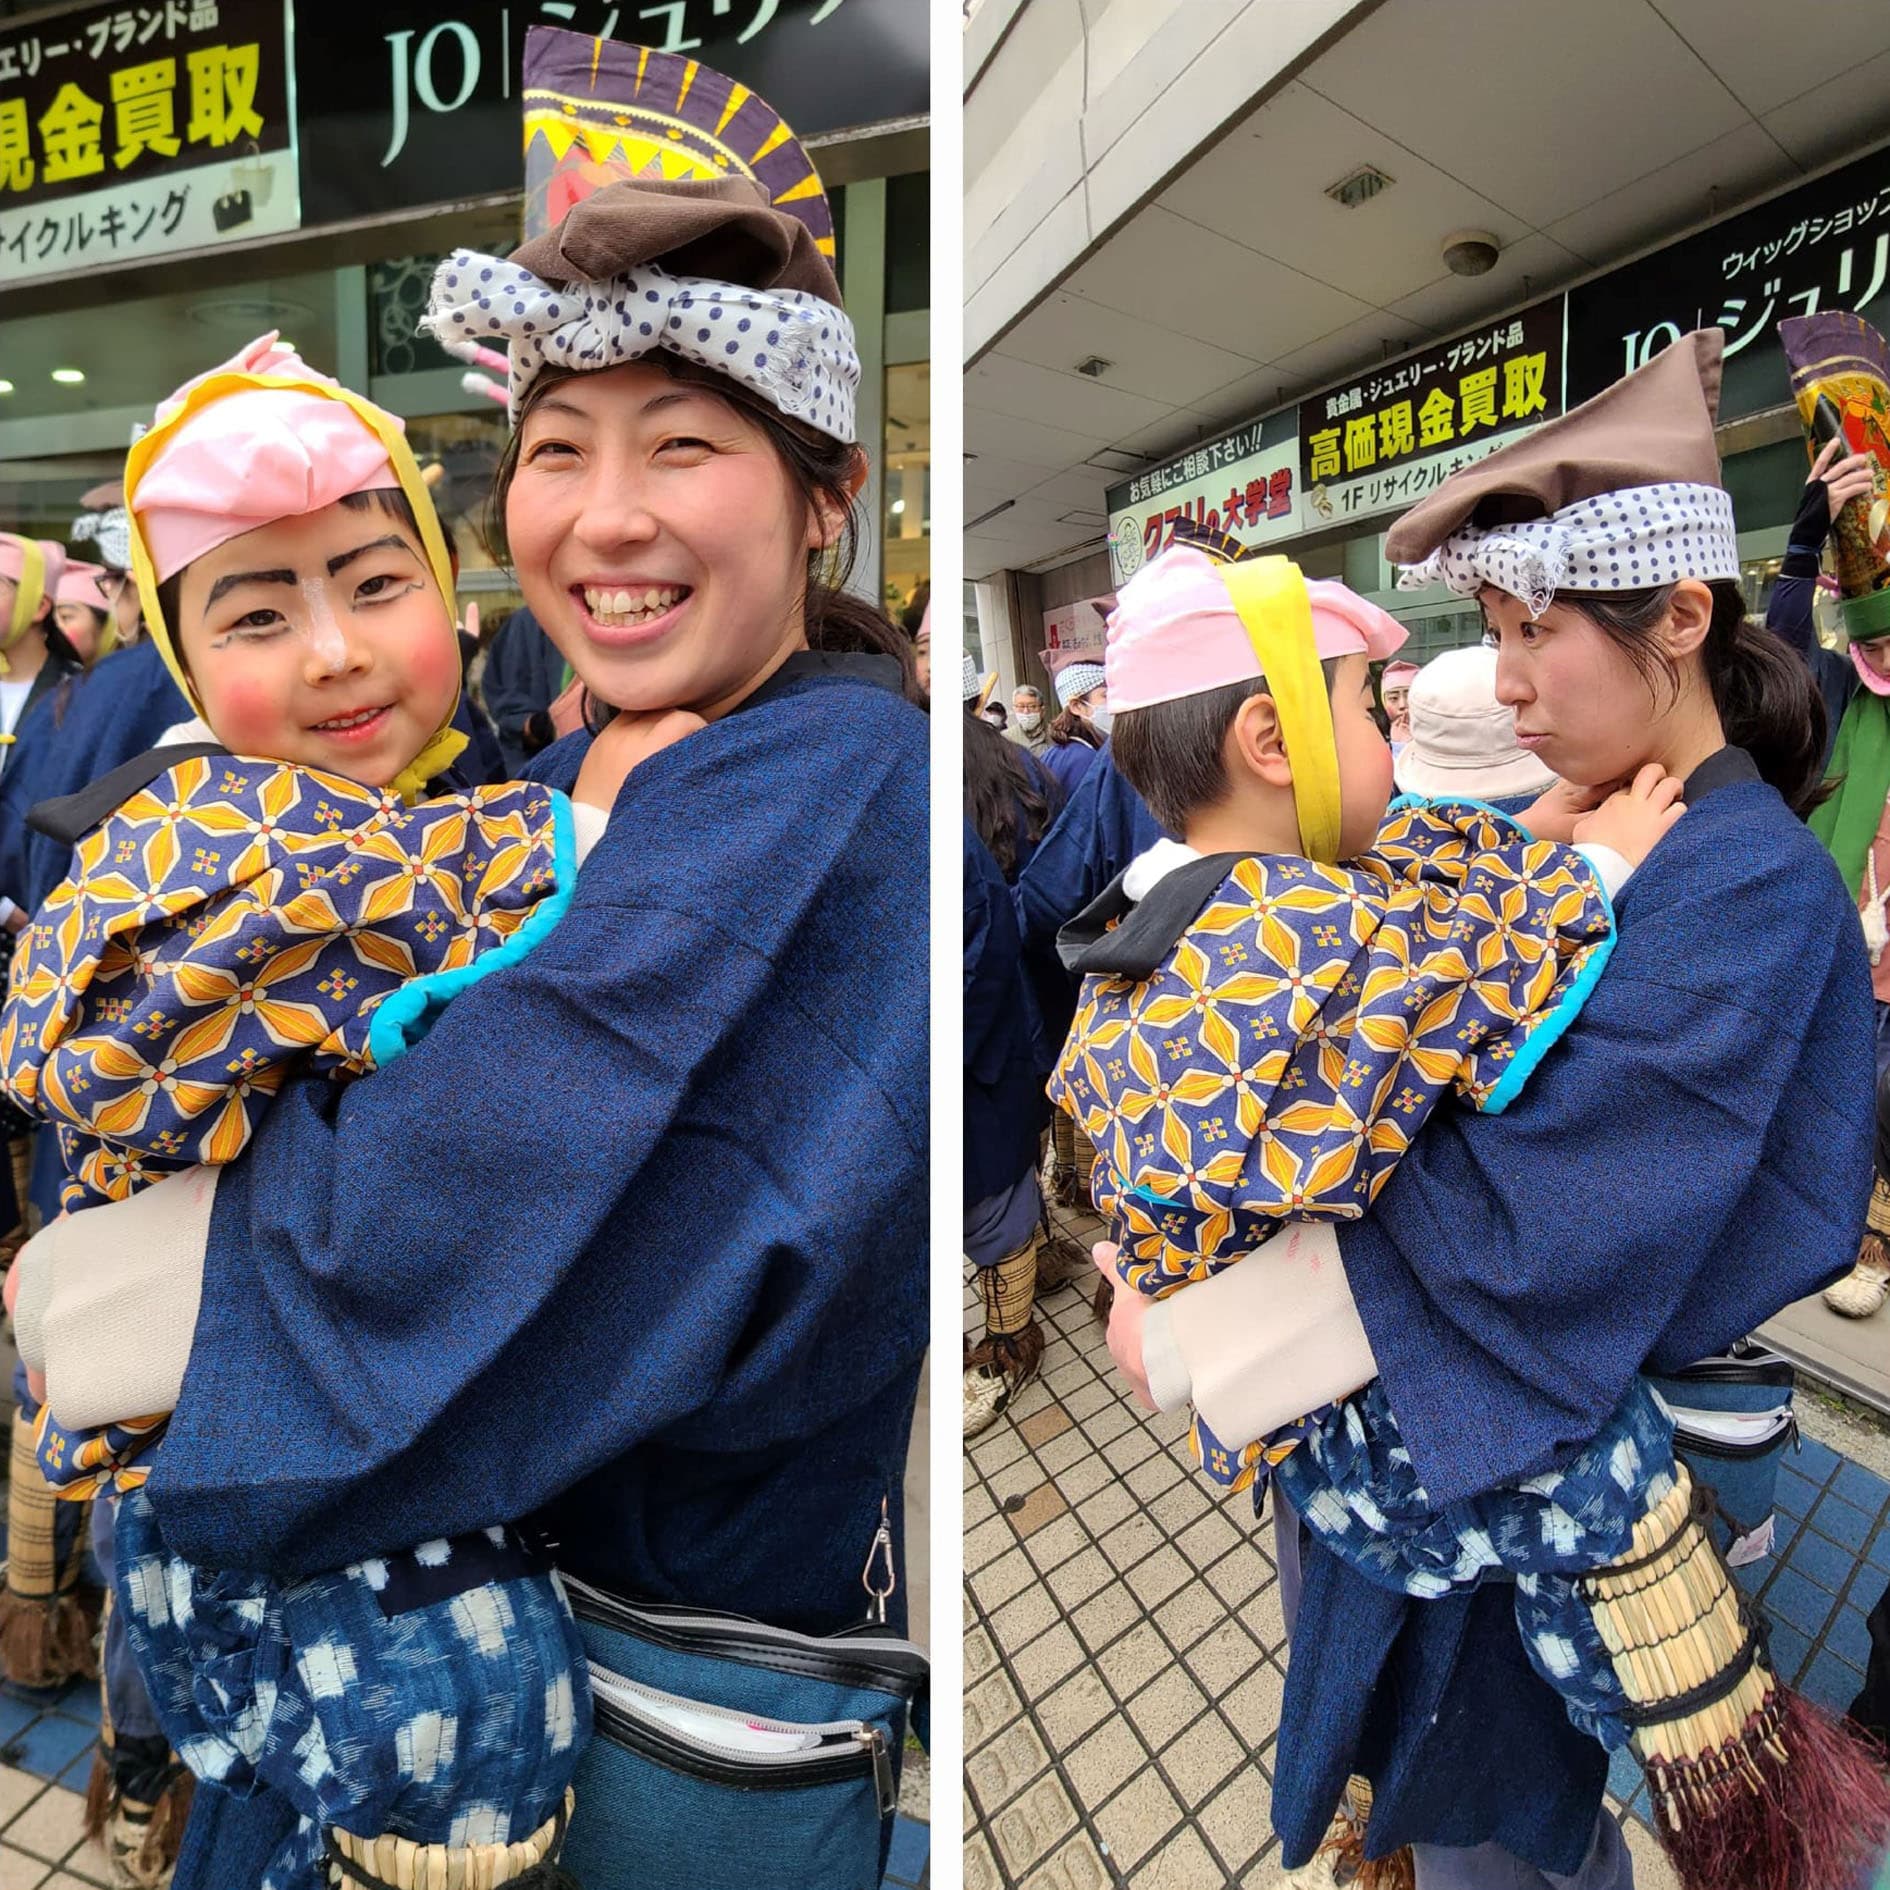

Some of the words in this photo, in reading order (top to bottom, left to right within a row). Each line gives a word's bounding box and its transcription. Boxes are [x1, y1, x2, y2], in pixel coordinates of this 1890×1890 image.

[379, 20, 481, 168] JO
[0, 184, 191, 263] イクルキング
[1309, 351, 1547, 482] 高価現金買取
[1341, 485, 1364, 512] 1F
[1370, 441, 1504, 504] リサイクルキ
